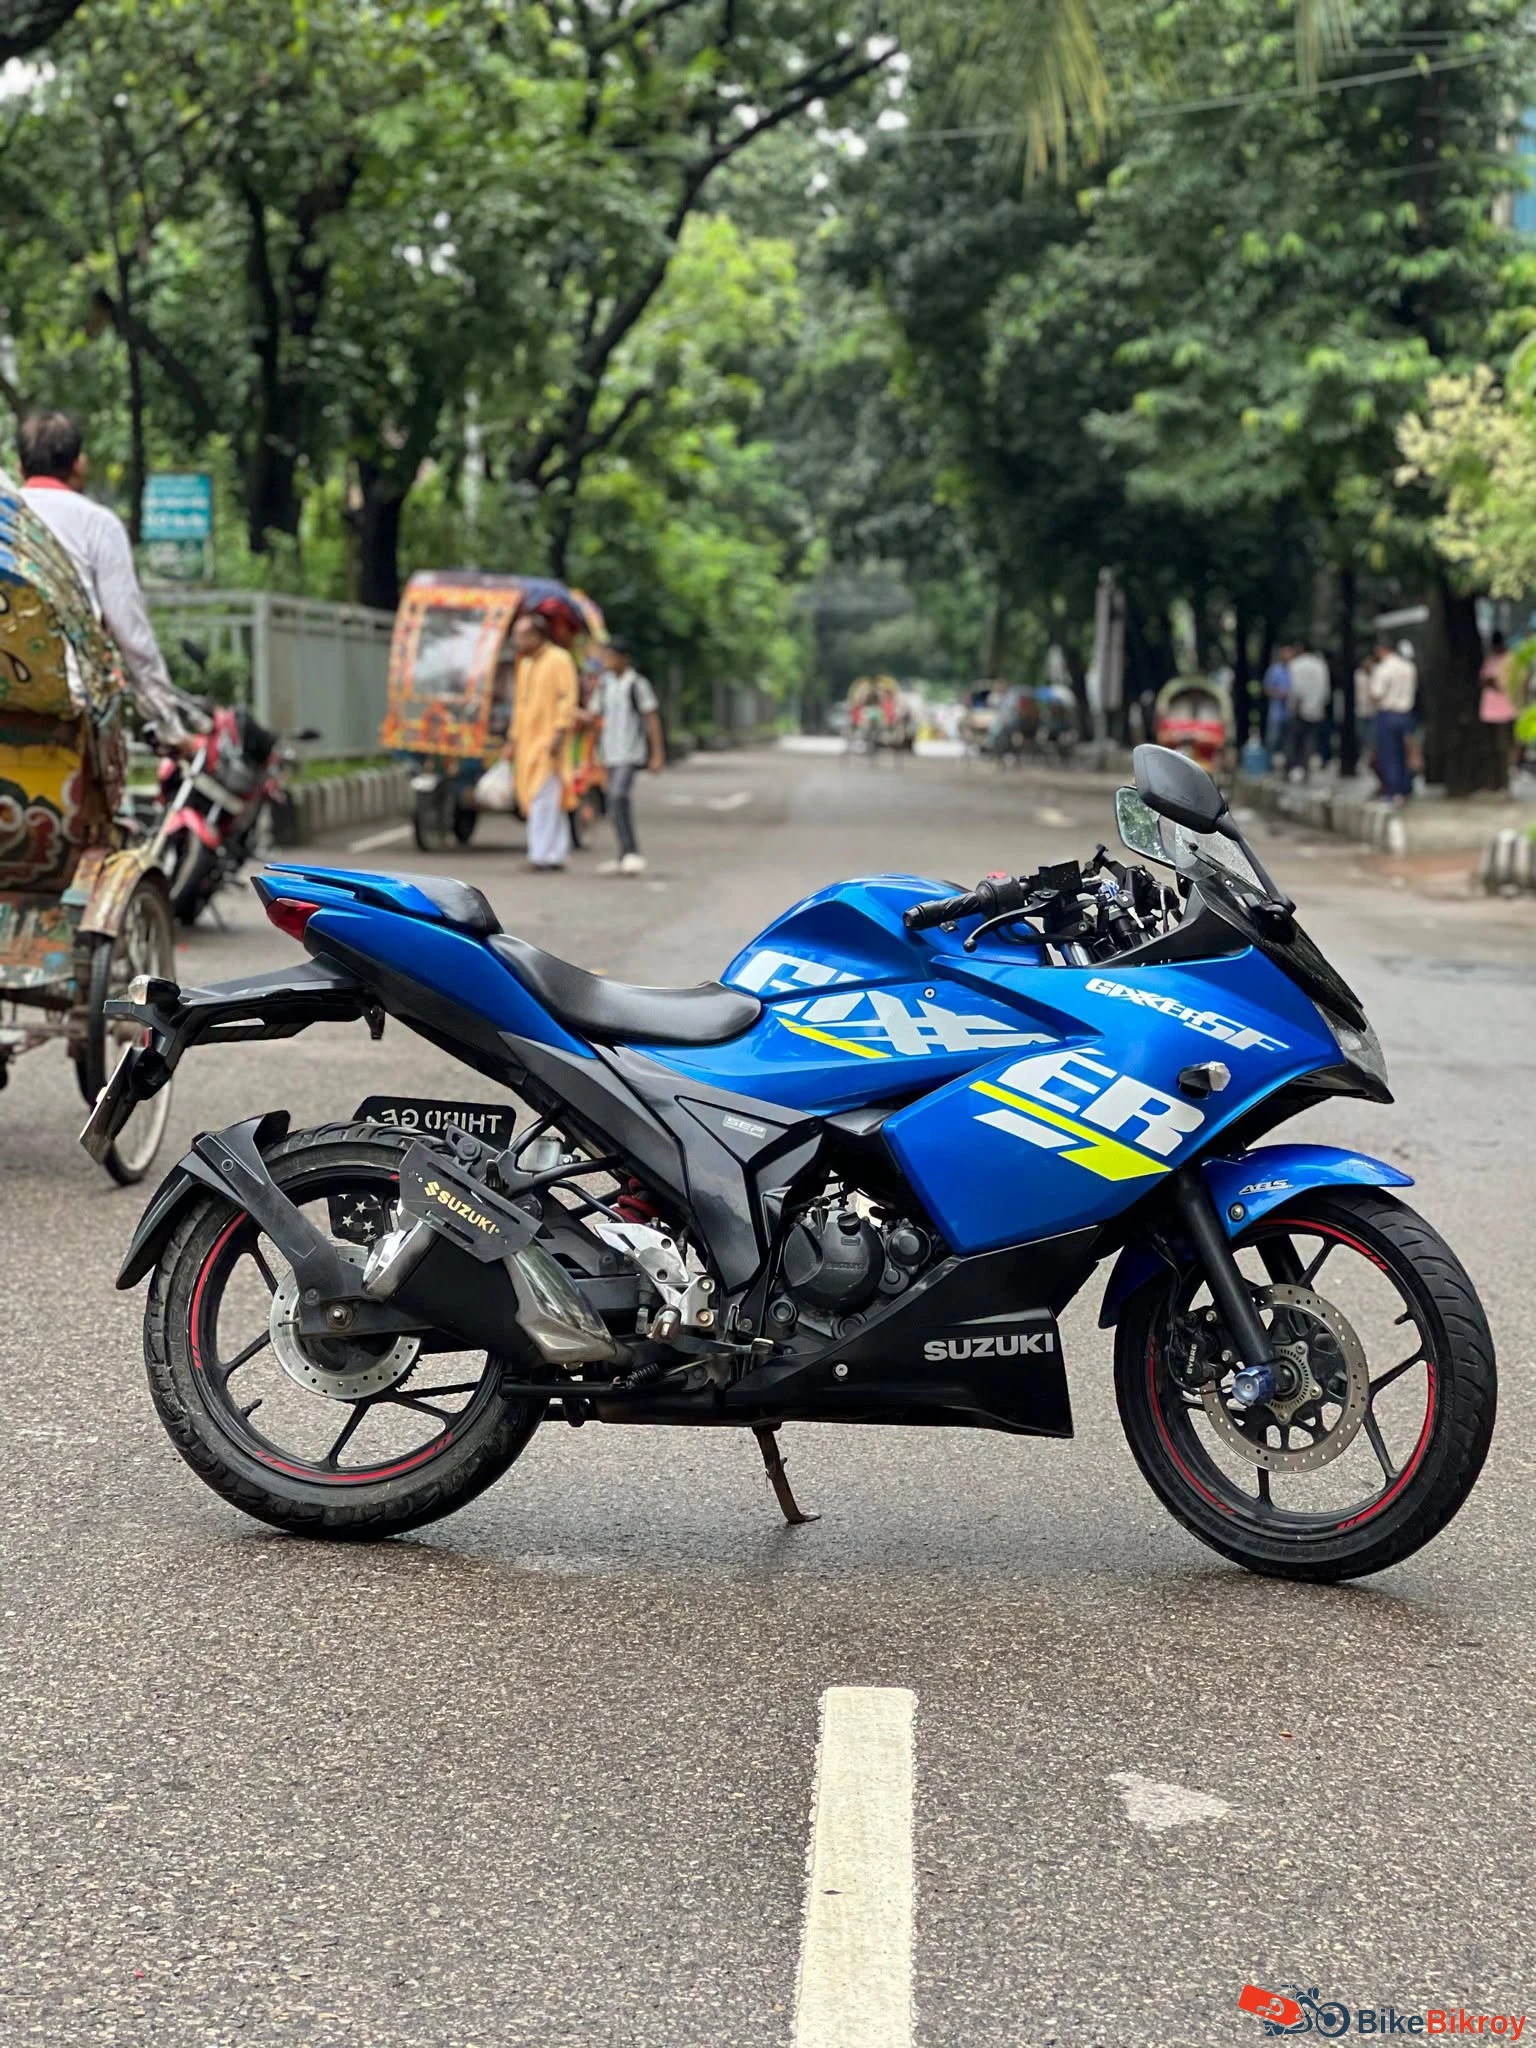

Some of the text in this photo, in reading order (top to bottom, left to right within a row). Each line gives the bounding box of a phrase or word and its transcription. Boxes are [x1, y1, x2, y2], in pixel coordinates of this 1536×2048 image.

[1239, 1179, 1290, 1195] ABS
[437, 1190, 497, 1235] SUZUKI
[923, 1332, 1054, 1361] SUZUKI
